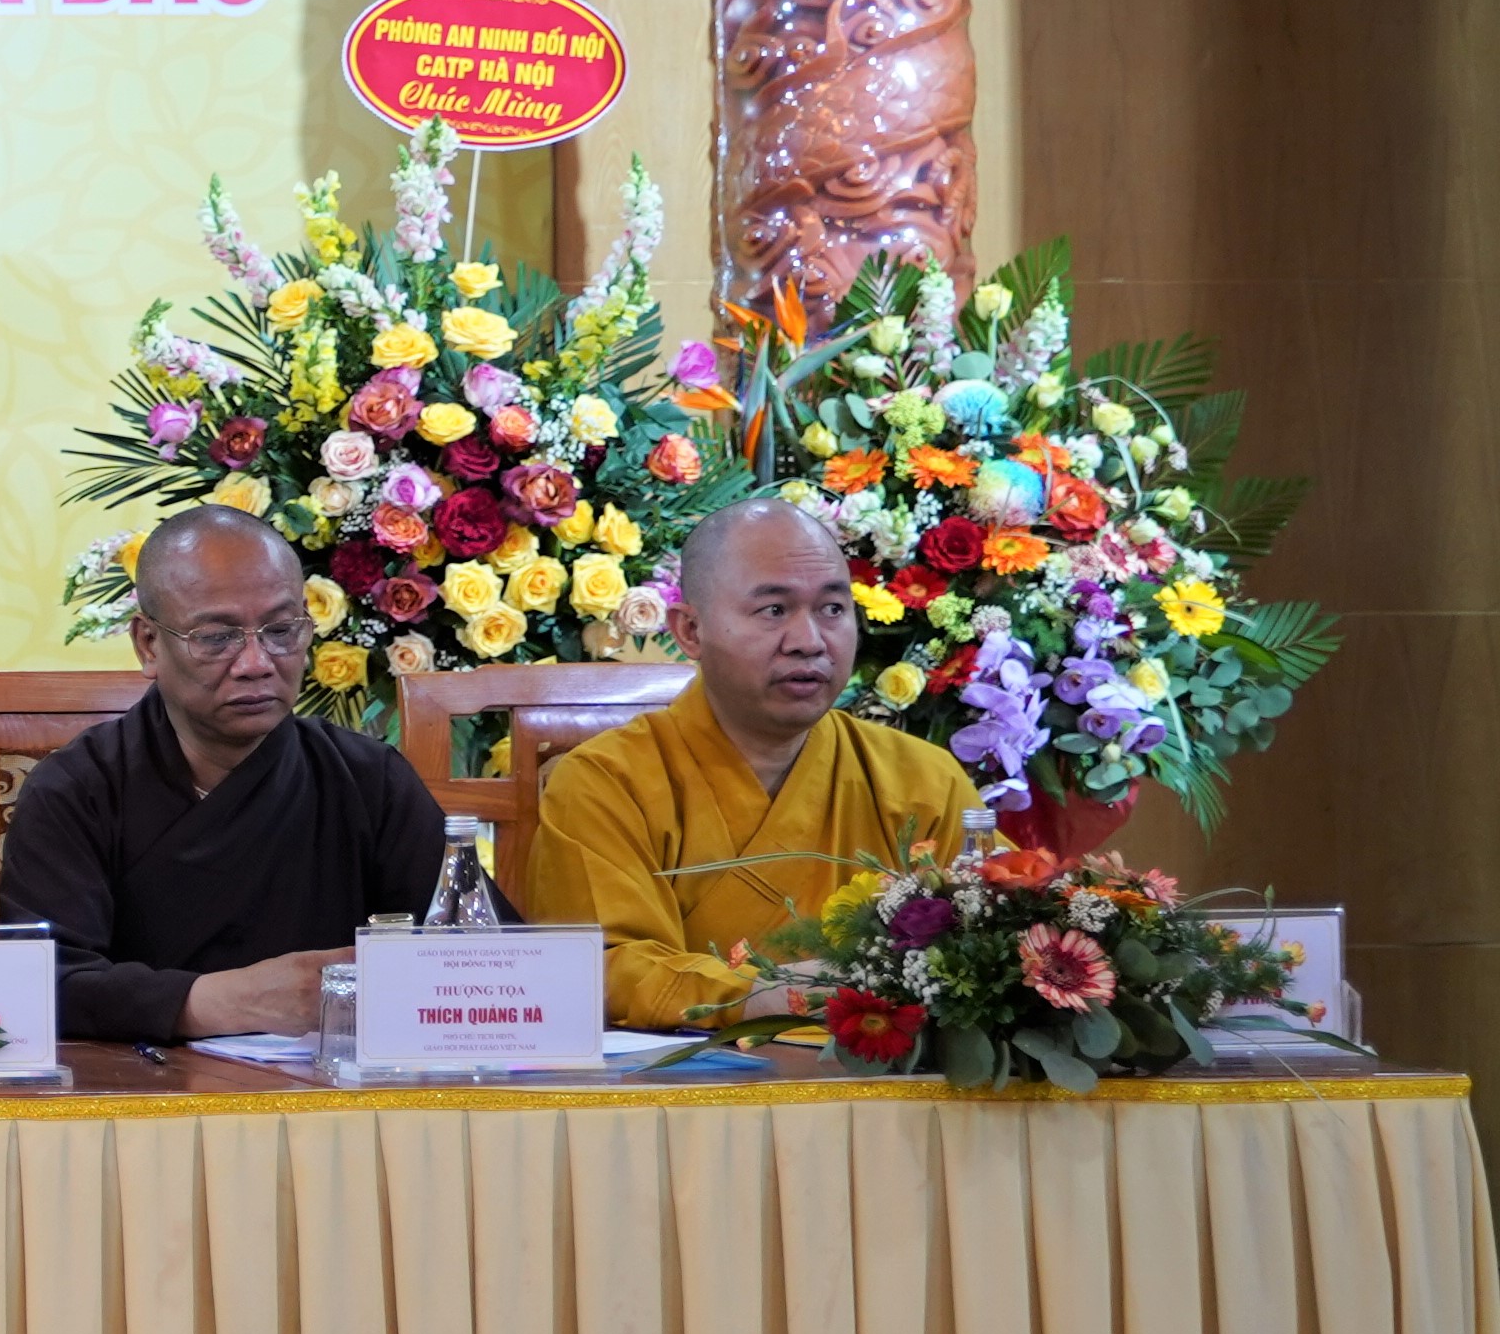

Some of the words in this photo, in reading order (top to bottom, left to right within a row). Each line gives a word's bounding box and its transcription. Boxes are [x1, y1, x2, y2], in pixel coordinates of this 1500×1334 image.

[375, 15, 443, 46] PHÒNG
[445, 24, 475, 48] AN
[478, 27, 528, 53] NINH
[531, 26, 567, 56] ĐỐI
[569, 32, 605, 63] NỘI
[416, 54, 474, 79] CATP
[478, 57, 509, 83] HÀ
[514, 60, 555, 90] NỘI
[399, 80, 471, 113] Chúc
[473, 88, 563, 126] Mừng
[434, 984, 493, 998] THƯỢNG
[497, 985, 525, 998] TỌA
[417, 1005, 462, 1024] THÍCH
[468, 1004, 517, 1025] QUẢNG
[523, 1004, 543, 1023] HÀ
